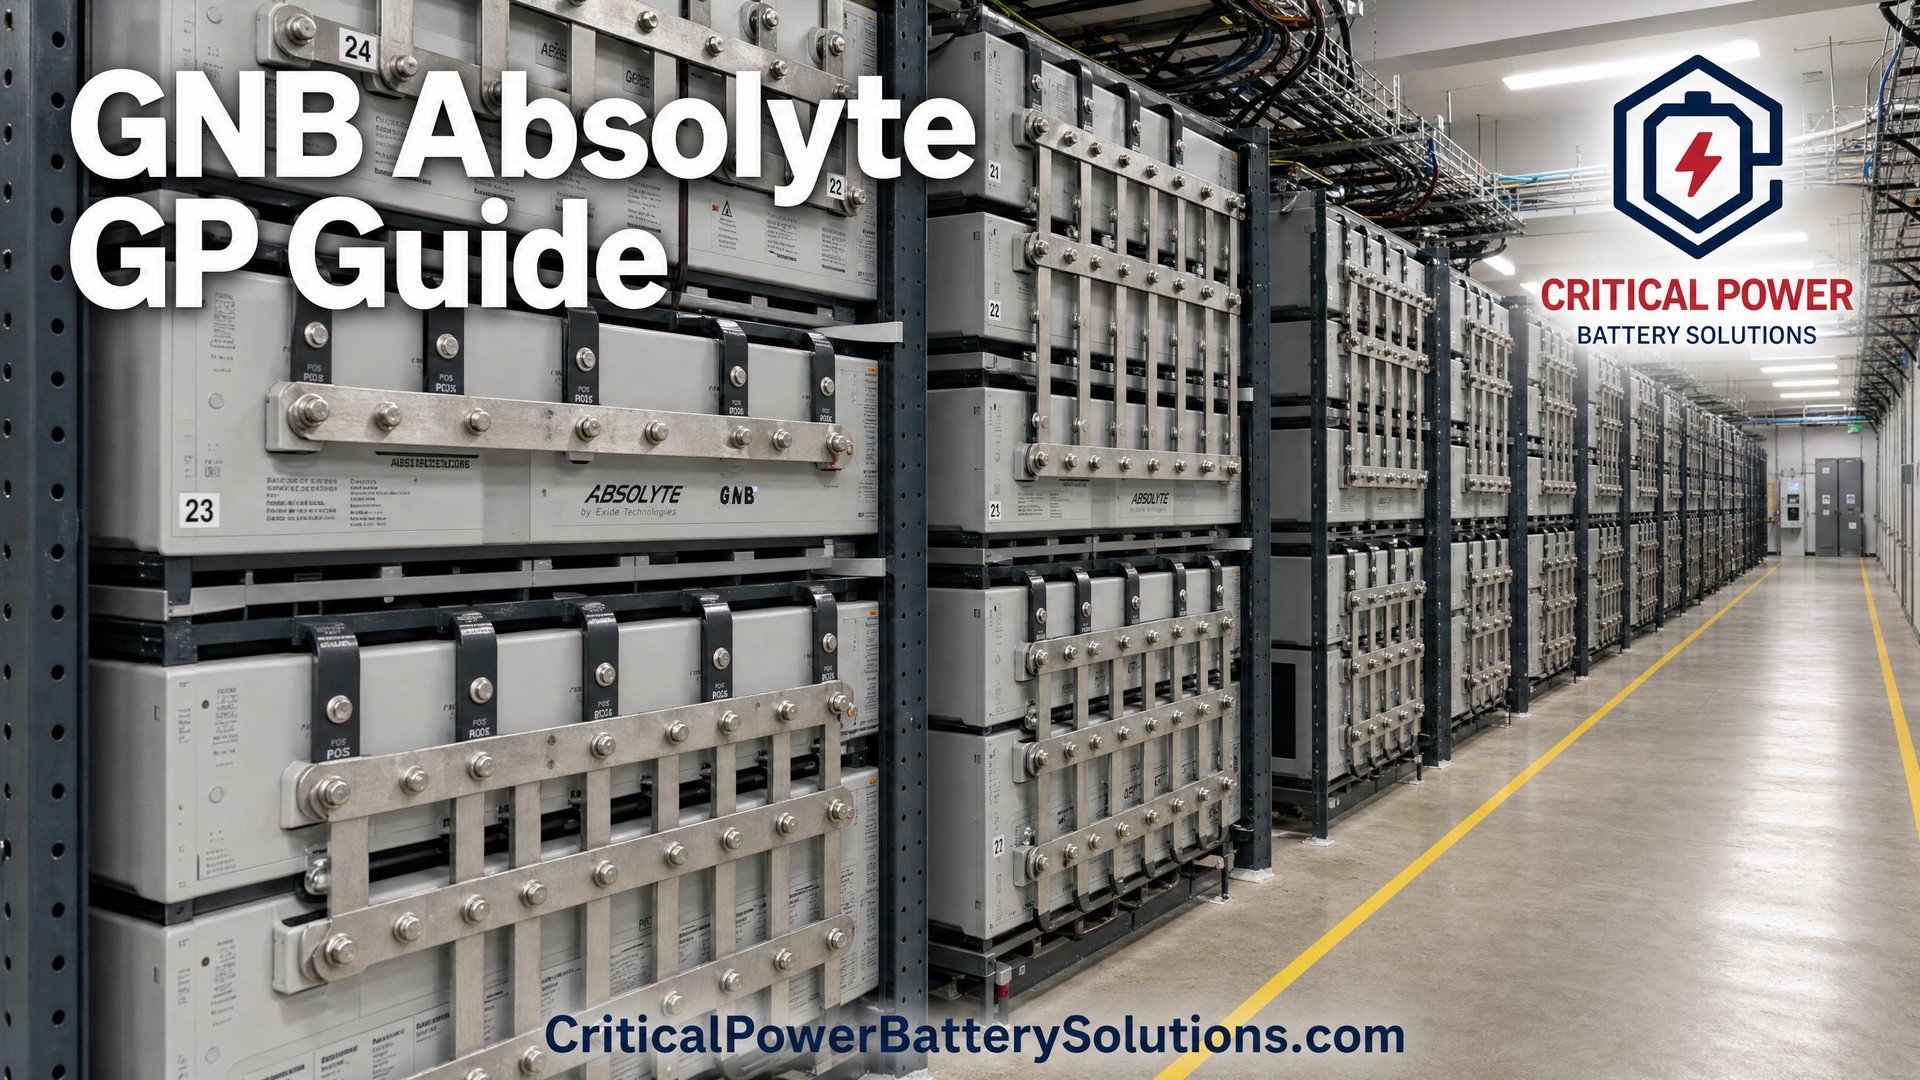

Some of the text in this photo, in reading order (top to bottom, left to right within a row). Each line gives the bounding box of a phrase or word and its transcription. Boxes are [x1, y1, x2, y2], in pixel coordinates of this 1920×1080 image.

[345, 35, 371, 63] 24
[989, 163, 999, 180] 21
[829, 177, 842, 196] 22
[989, 302, 1000, 318] 22
[583, 484, 684, 504] ABSOLYTE
[719, 485, 755, 505] GNB
[1131, 492, 1169, 504] ABSOLYTE
[185, 498, 214, 523] 23
[580, 507, 677, 519] by Exide Technologies
[326, 747, 351, 760] POS
